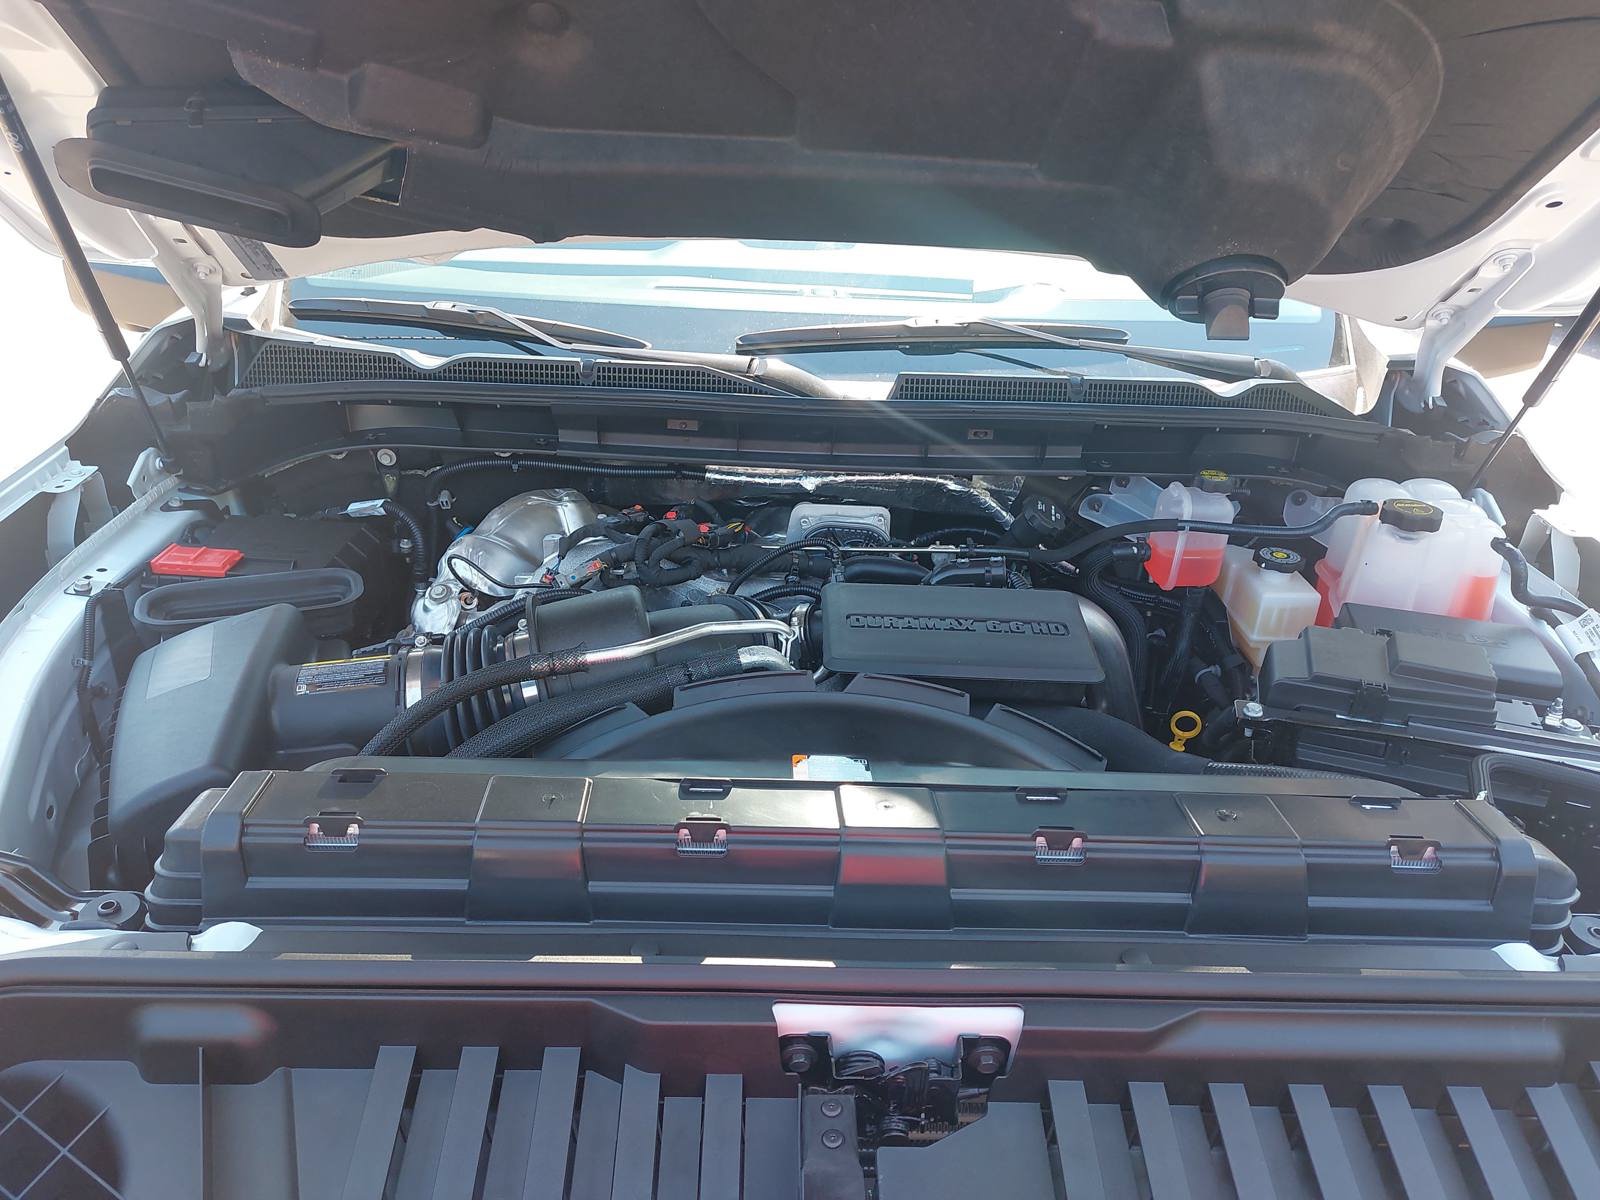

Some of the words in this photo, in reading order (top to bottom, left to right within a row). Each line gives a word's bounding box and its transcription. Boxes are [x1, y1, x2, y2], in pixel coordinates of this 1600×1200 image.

[849, 614, 977, 632] DURAMAX
[986, 620, 1025, 635] 6.6
[1031, 622, 1067, 636] HD
